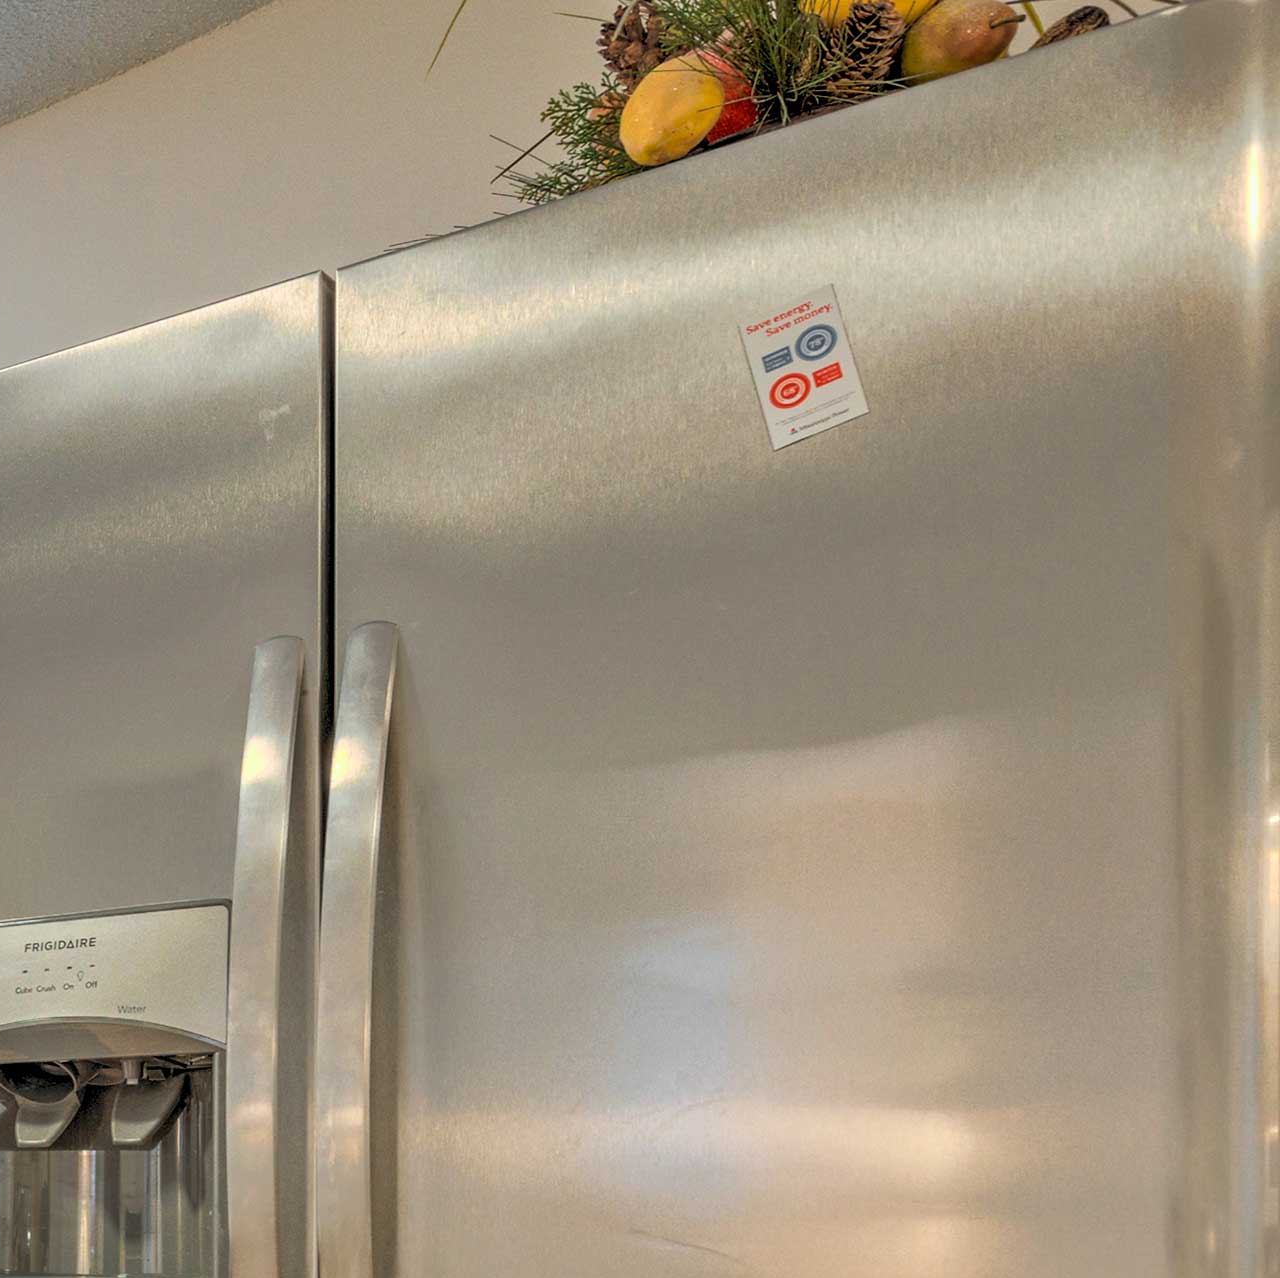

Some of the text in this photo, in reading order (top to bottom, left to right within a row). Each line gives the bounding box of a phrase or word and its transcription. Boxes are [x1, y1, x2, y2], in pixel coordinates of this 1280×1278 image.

[746, 319, 771, 335] Save
[766, 321, 792, 336] Save
[24, 937, 97, 952] FRIGIDAIRE
[36, 984, 56, 992] Crush
[63, 980, 98, 991] On Off
[117, 1004, 147, 1015] Water
